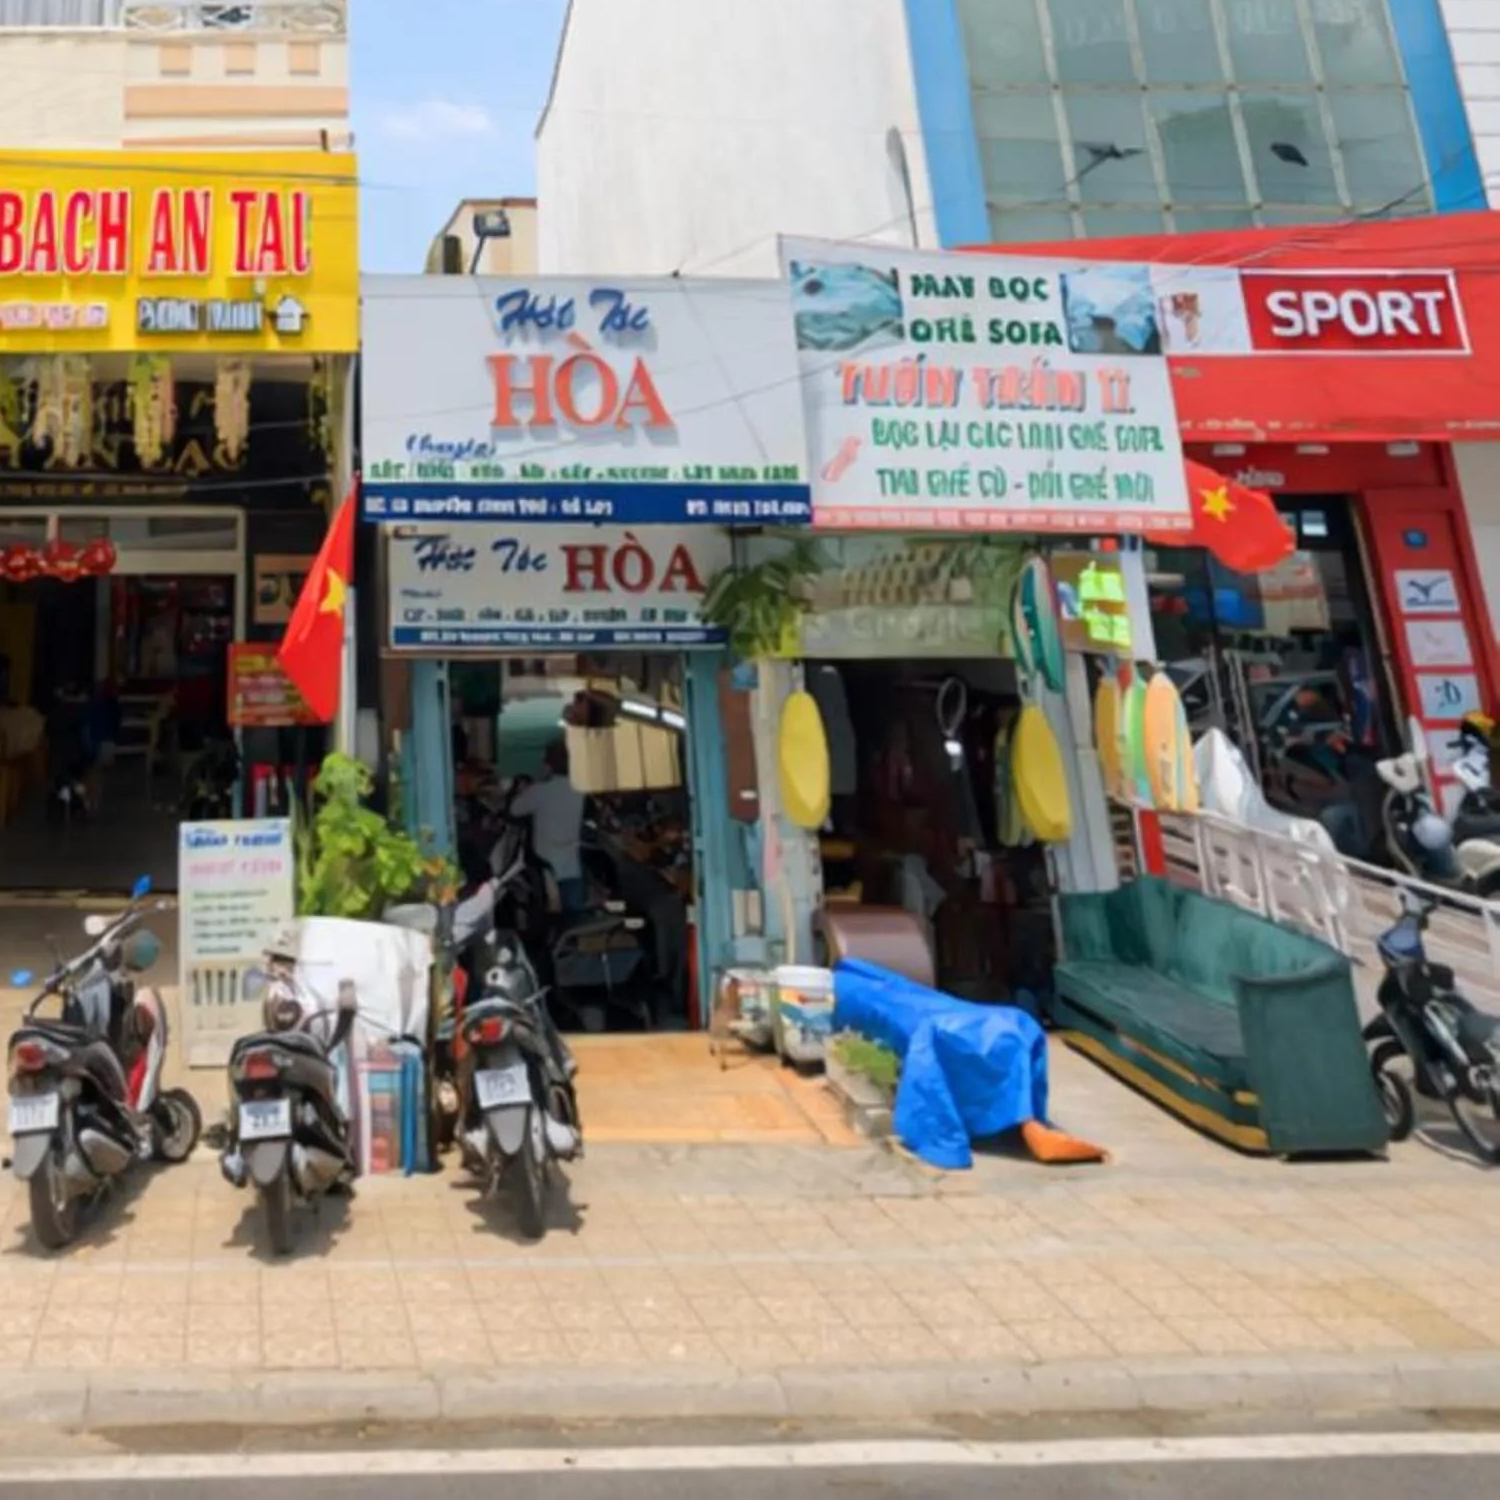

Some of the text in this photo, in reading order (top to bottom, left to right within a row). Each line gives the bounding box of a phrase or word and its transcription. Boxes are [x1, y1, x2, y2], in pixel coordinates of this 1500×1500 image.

[146, 188, 211, 275] AN
[1266, 289, 1446, 337] SPORT
[484, 331, 677, 431] HÒA
[560, 531, 707, 593] HÒA
